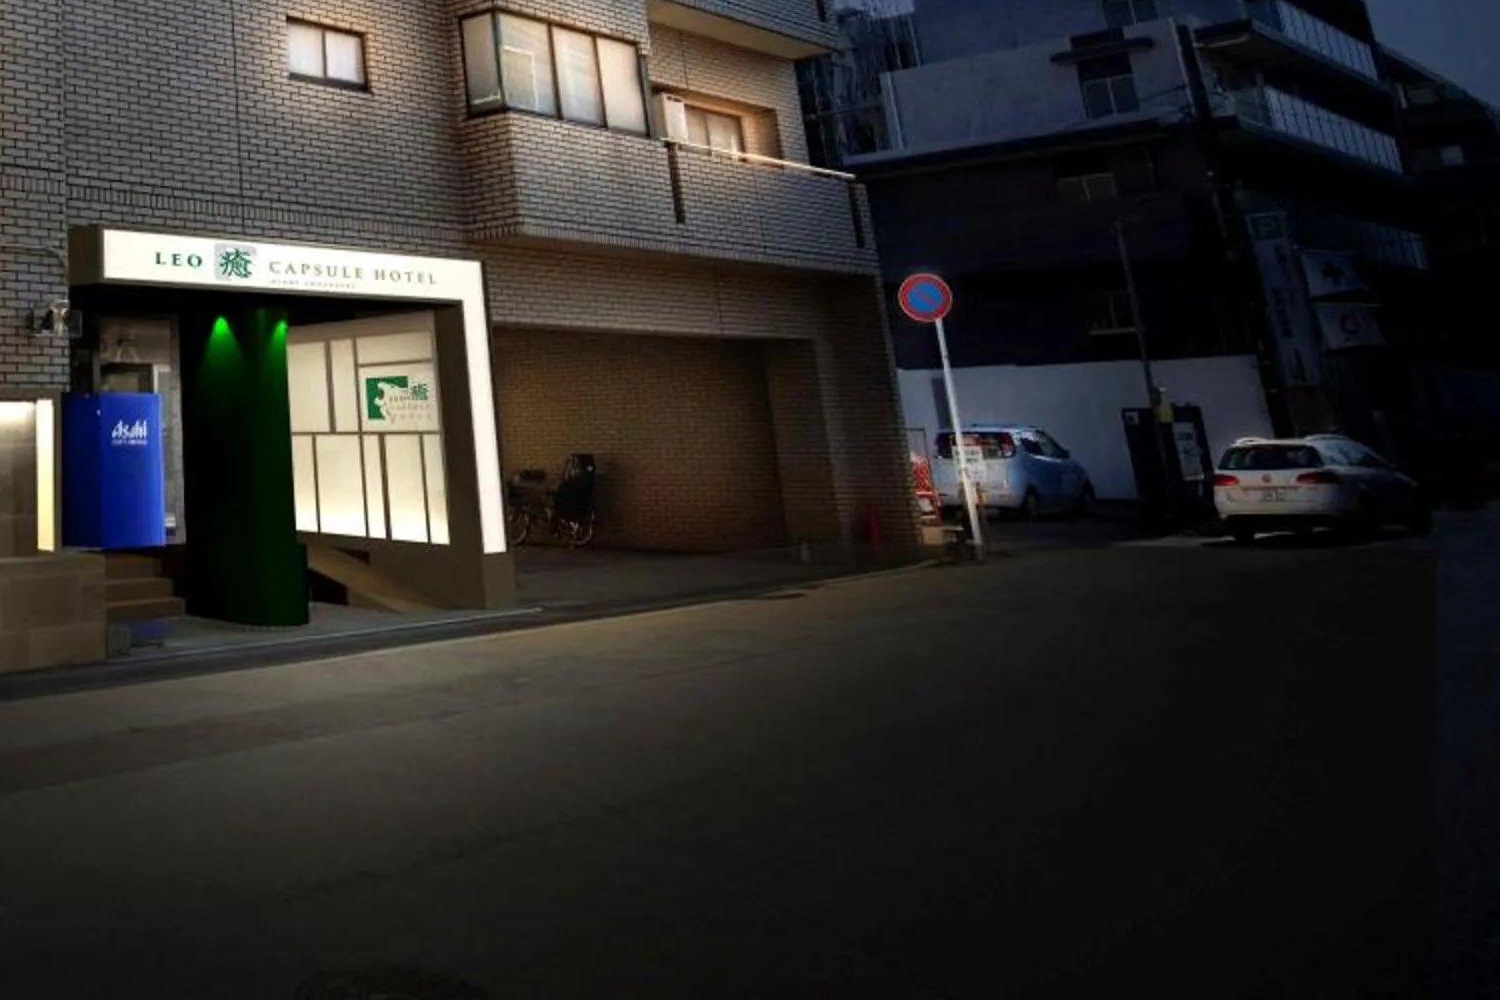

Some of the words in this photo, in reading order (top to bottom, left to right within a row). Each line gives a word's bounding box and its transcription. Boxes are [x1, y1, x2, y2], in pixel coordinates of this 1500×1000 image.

[154, 250, 204, 269] LEO
[218, 248, 253, 279] 癒
[268, 260, 364, 281] CAPSULE
[373, 268, 437, 286] HOTEL
[111, 418, 148, 439] Asahi
